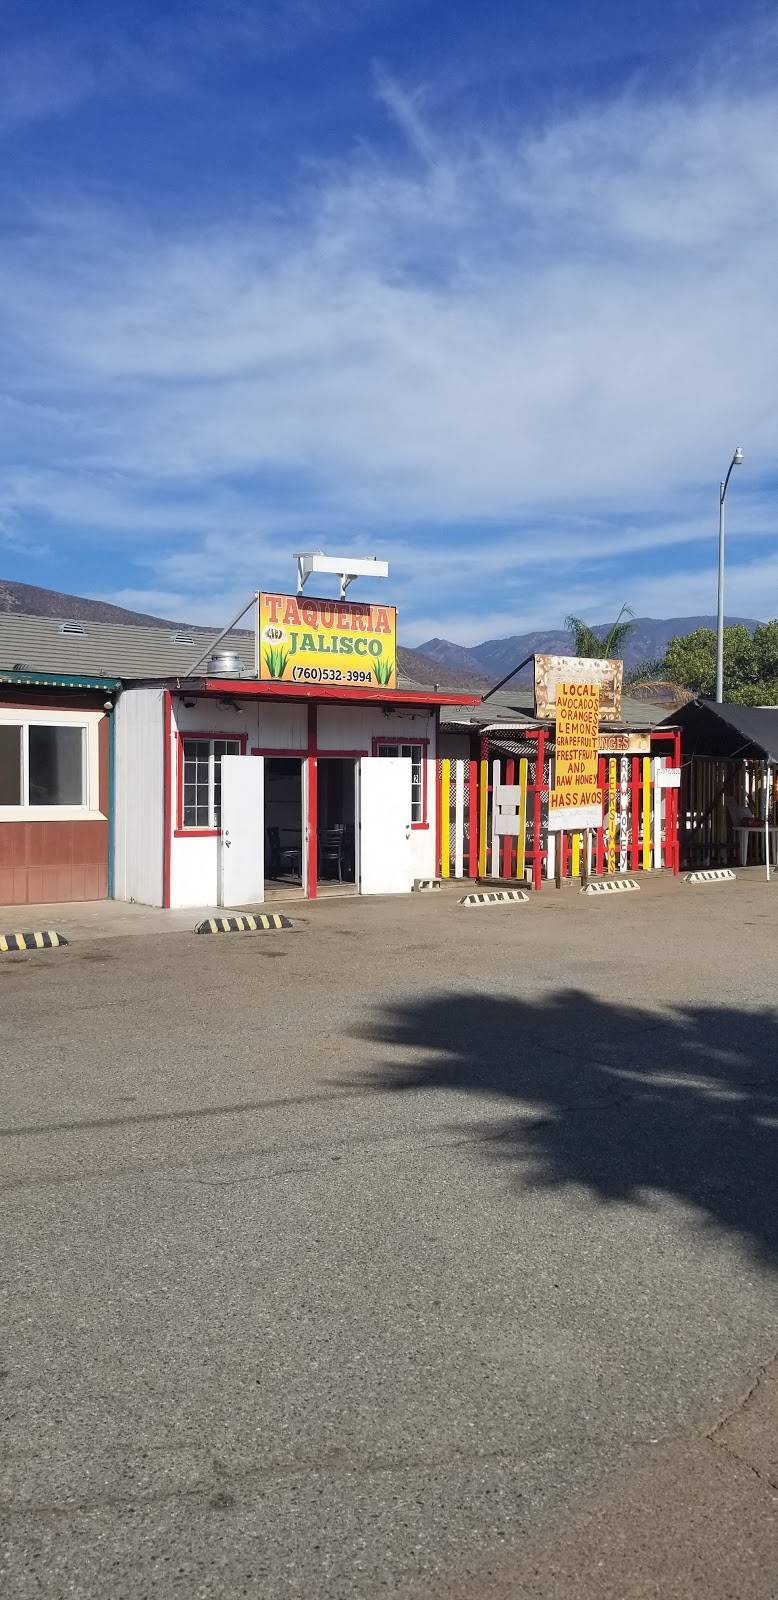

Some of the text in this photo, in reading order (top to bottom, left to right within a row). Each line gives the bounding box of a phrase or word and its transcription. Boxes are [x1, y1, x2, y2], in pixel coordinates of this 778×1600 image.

[265, 595, 392, 633] TAQUERIA
[289, 632, 383, 656] JALISCO
[292, 666, 372, 682] (760)532-3994
[563, 684, 596, 697] LOCAL
[557, 697, 599, 711] AVOCADOS
[560, 709, 598, 725] ORANGES
[559, 722, 598, 737] LEMONS
[557, 736, 597, 748] GRAPEFRUIT
[567, 762, 586, 773] AND
[557, 774, 598, 786] RAW HONEY
[551, 792, 602, 807] HASS AVOS
